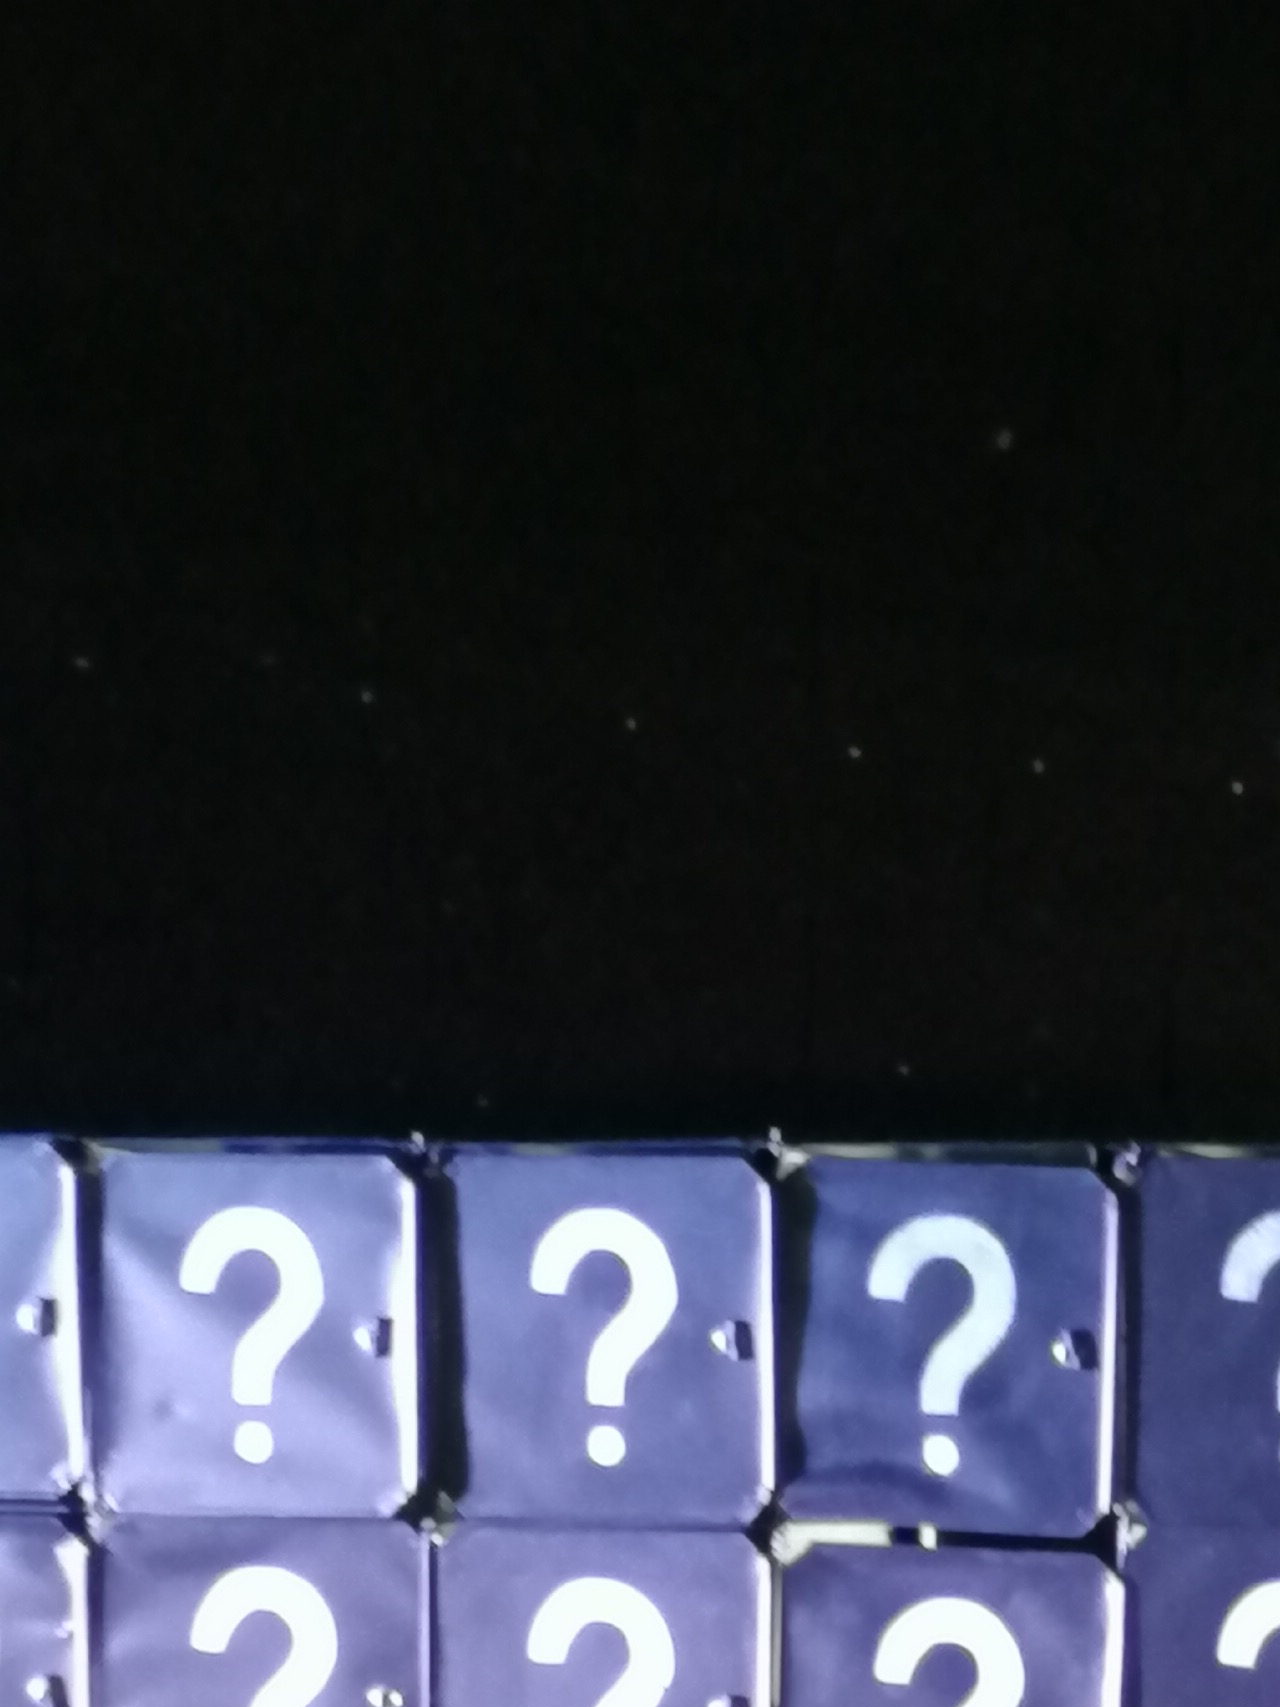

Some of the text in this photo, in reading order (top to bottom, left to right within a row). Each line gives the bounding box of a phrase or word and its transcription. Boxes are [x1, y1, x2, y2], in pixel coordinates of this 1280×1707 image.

[180, 1206, 325, 1465] ?
[529, 1203, 678, 1466] ?
[867, 1210, 1016, 1477] ?
